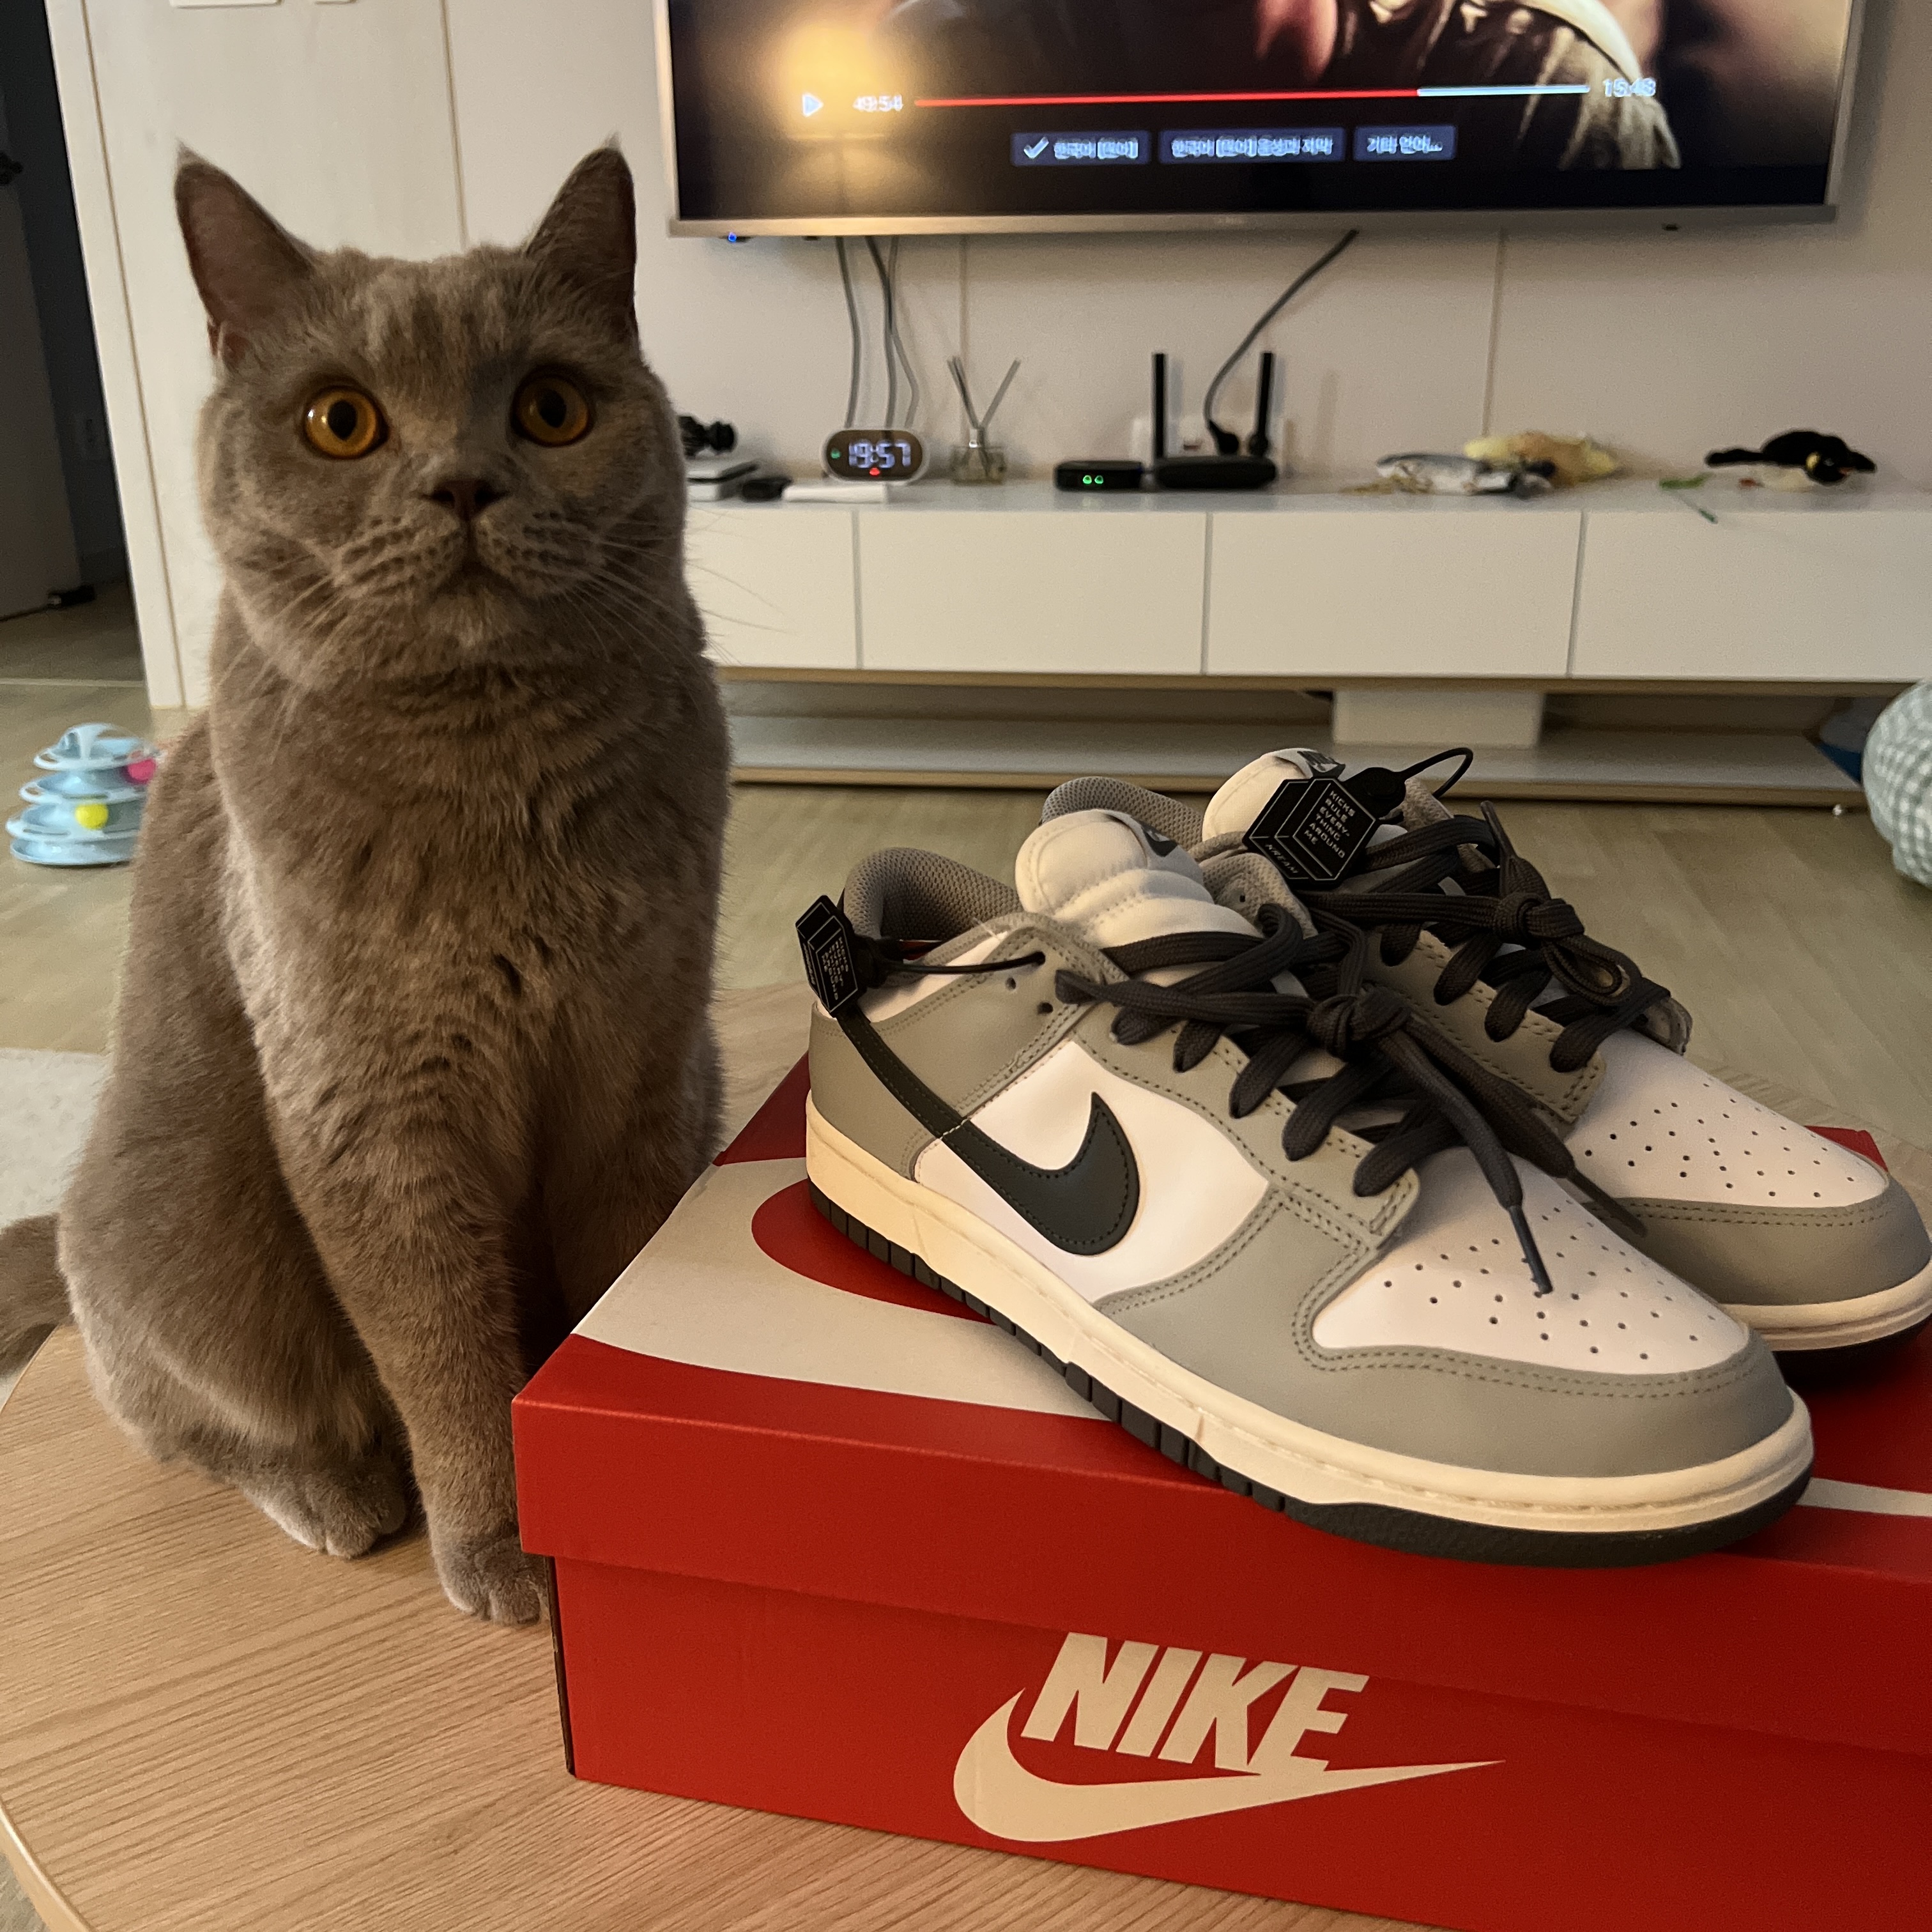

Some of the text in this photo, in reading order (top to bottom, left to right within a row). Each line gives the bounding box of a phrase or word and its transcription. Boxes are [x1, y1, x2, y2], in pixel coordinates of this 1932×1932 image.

[848, 439, 911, 468] 19:57
[1325, 798, 1347, 823] RULE
[1330, 790, 1356, 816] KICKS
[1315, 813, 1341, 841] THING
[1319, 806, 1350, 837] EVERY-
[1304, 831, 1319, 845] ME
[1309, 823, 1346, 858] AROUND
[1265, 844, 1299, 873] KREAM
[1020, 1631, 1370, 1775] NIKE
